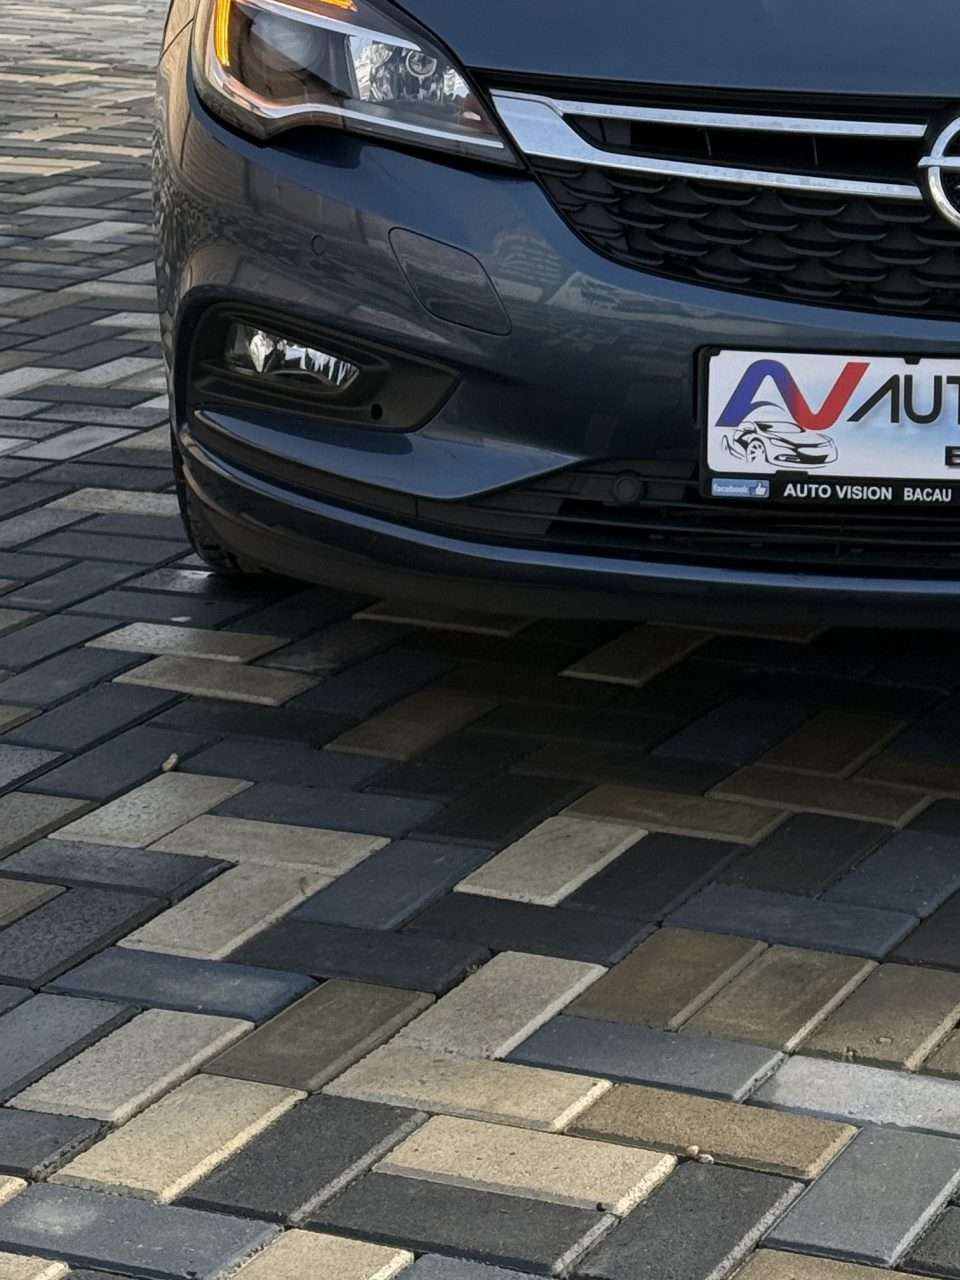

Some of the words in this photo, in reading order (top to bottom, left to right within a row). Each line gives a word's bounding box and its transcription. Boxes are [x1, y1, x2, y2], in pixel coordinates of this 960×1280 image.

[784, 483, 831, 498] AUTO
[836, 485, 893, 501] VISION
[903, 487, 951, 502] BACAU
